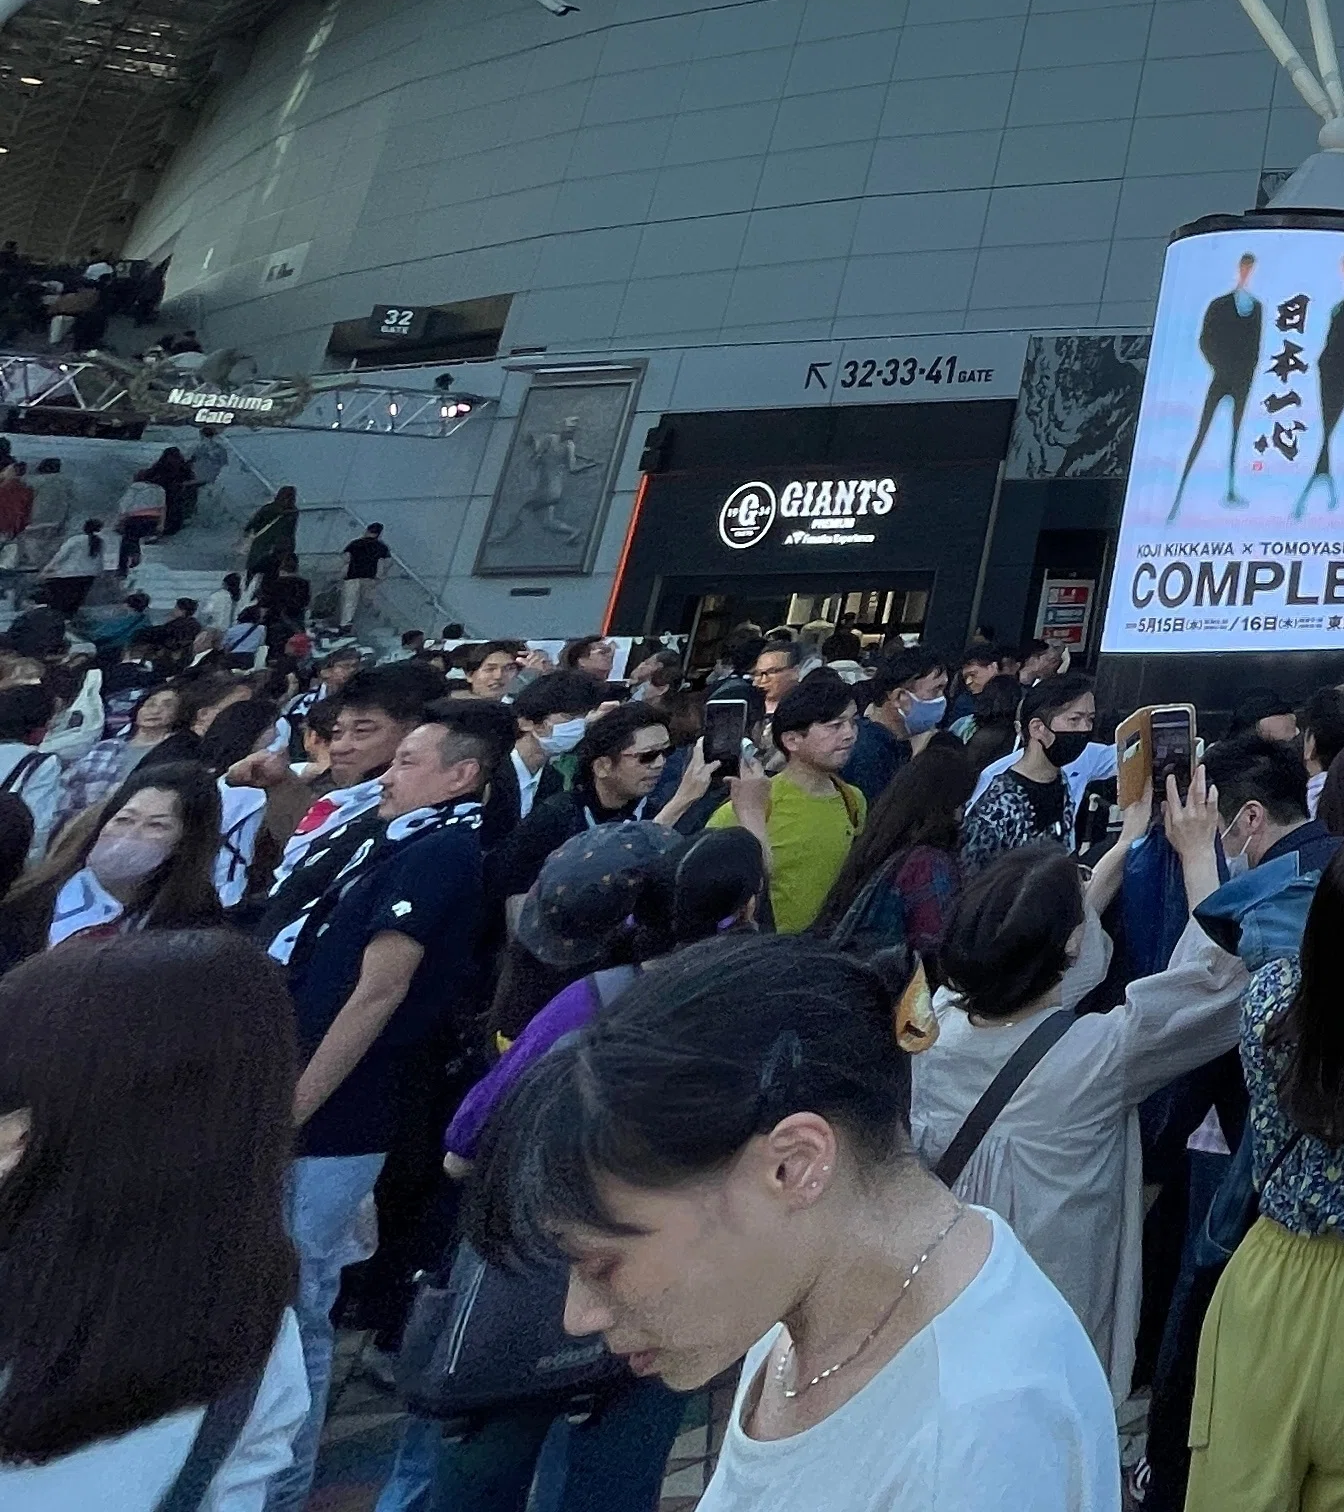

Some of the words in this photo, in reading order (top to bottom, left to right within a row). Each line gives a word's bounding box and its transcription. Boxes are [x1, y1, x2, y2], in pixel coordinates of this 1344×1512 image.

[384, 309, 414, 326] 32
[957, 368, 994, 383] GATE
[1253, 293, 1311, 462] 日本一心
[168, 389, 273, 412] Nagashima
[194, 408, 235, 425] Gate
[780, 478, 897, 517] GIANTS
[1137, 543, 1161, 558] KOJI
[1164, 542, 1234, 556] KIKKAWA
